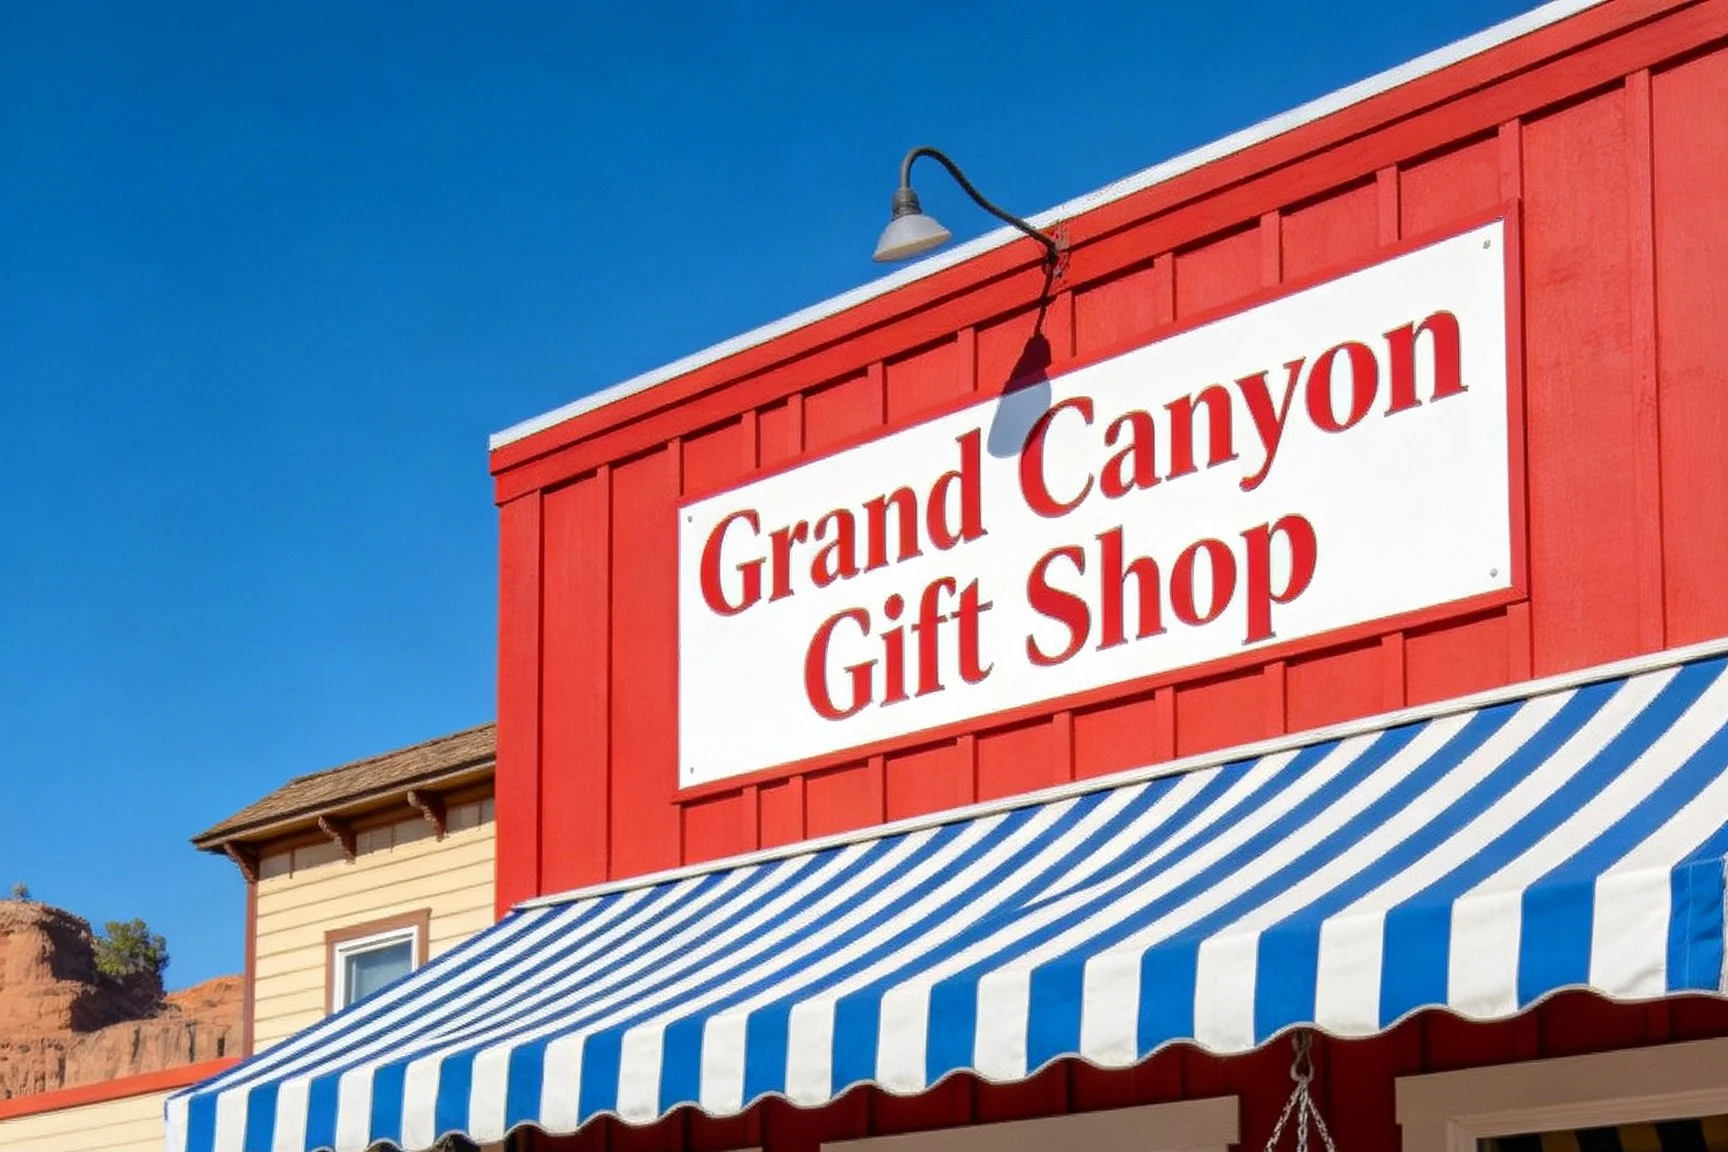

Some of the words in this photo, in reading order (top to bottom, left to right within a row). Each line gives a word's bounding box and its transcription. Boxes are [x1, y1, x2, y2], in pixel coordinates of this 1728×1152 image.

[699, 428, 988, 616] Grand
[1018, 310, 1468, 519] Canyon
[803, 508, 992, 722] Gift
[1025, 513, 1318, 667] Shop
